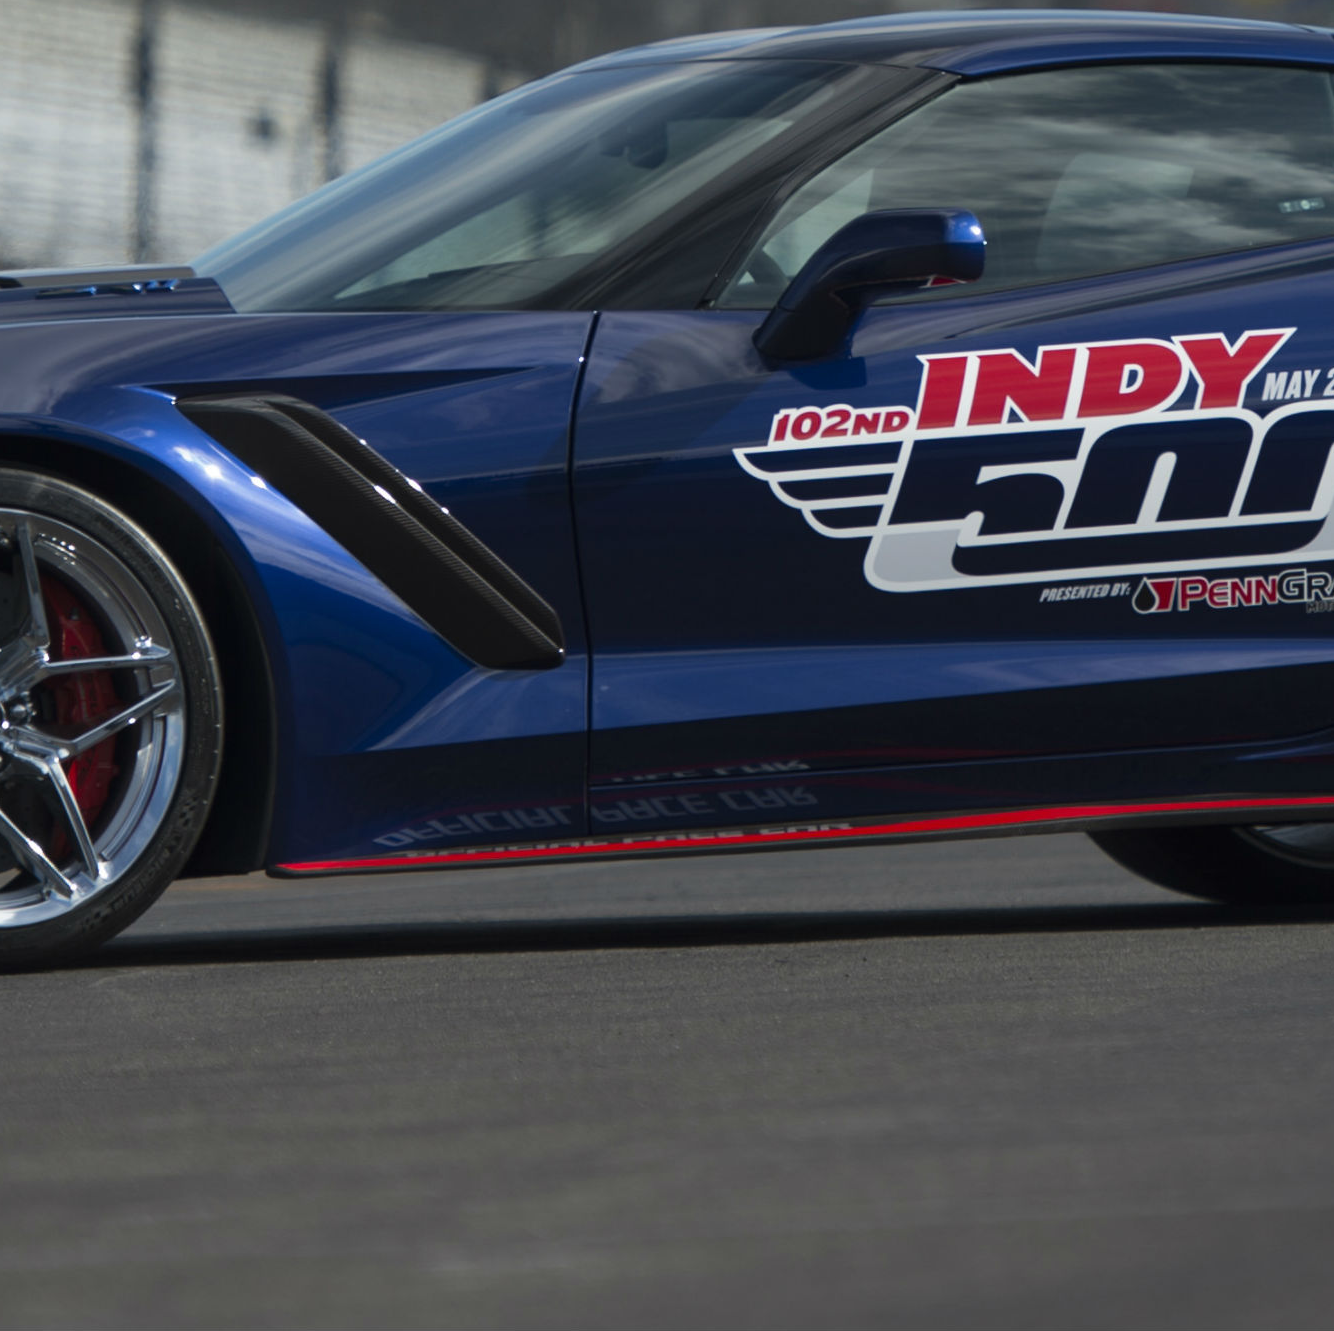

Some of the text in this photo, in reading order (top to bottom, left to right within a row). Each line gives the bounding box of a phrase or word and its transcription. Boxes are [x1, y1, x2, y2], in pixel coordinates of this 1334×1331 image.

[916, 331, 1293, 432] INDY
[1261, 369, 1320, 401] MAY
[772, 407, 911, 442] 102ND
[1039, 584, 1111, 603] PRESENTED
